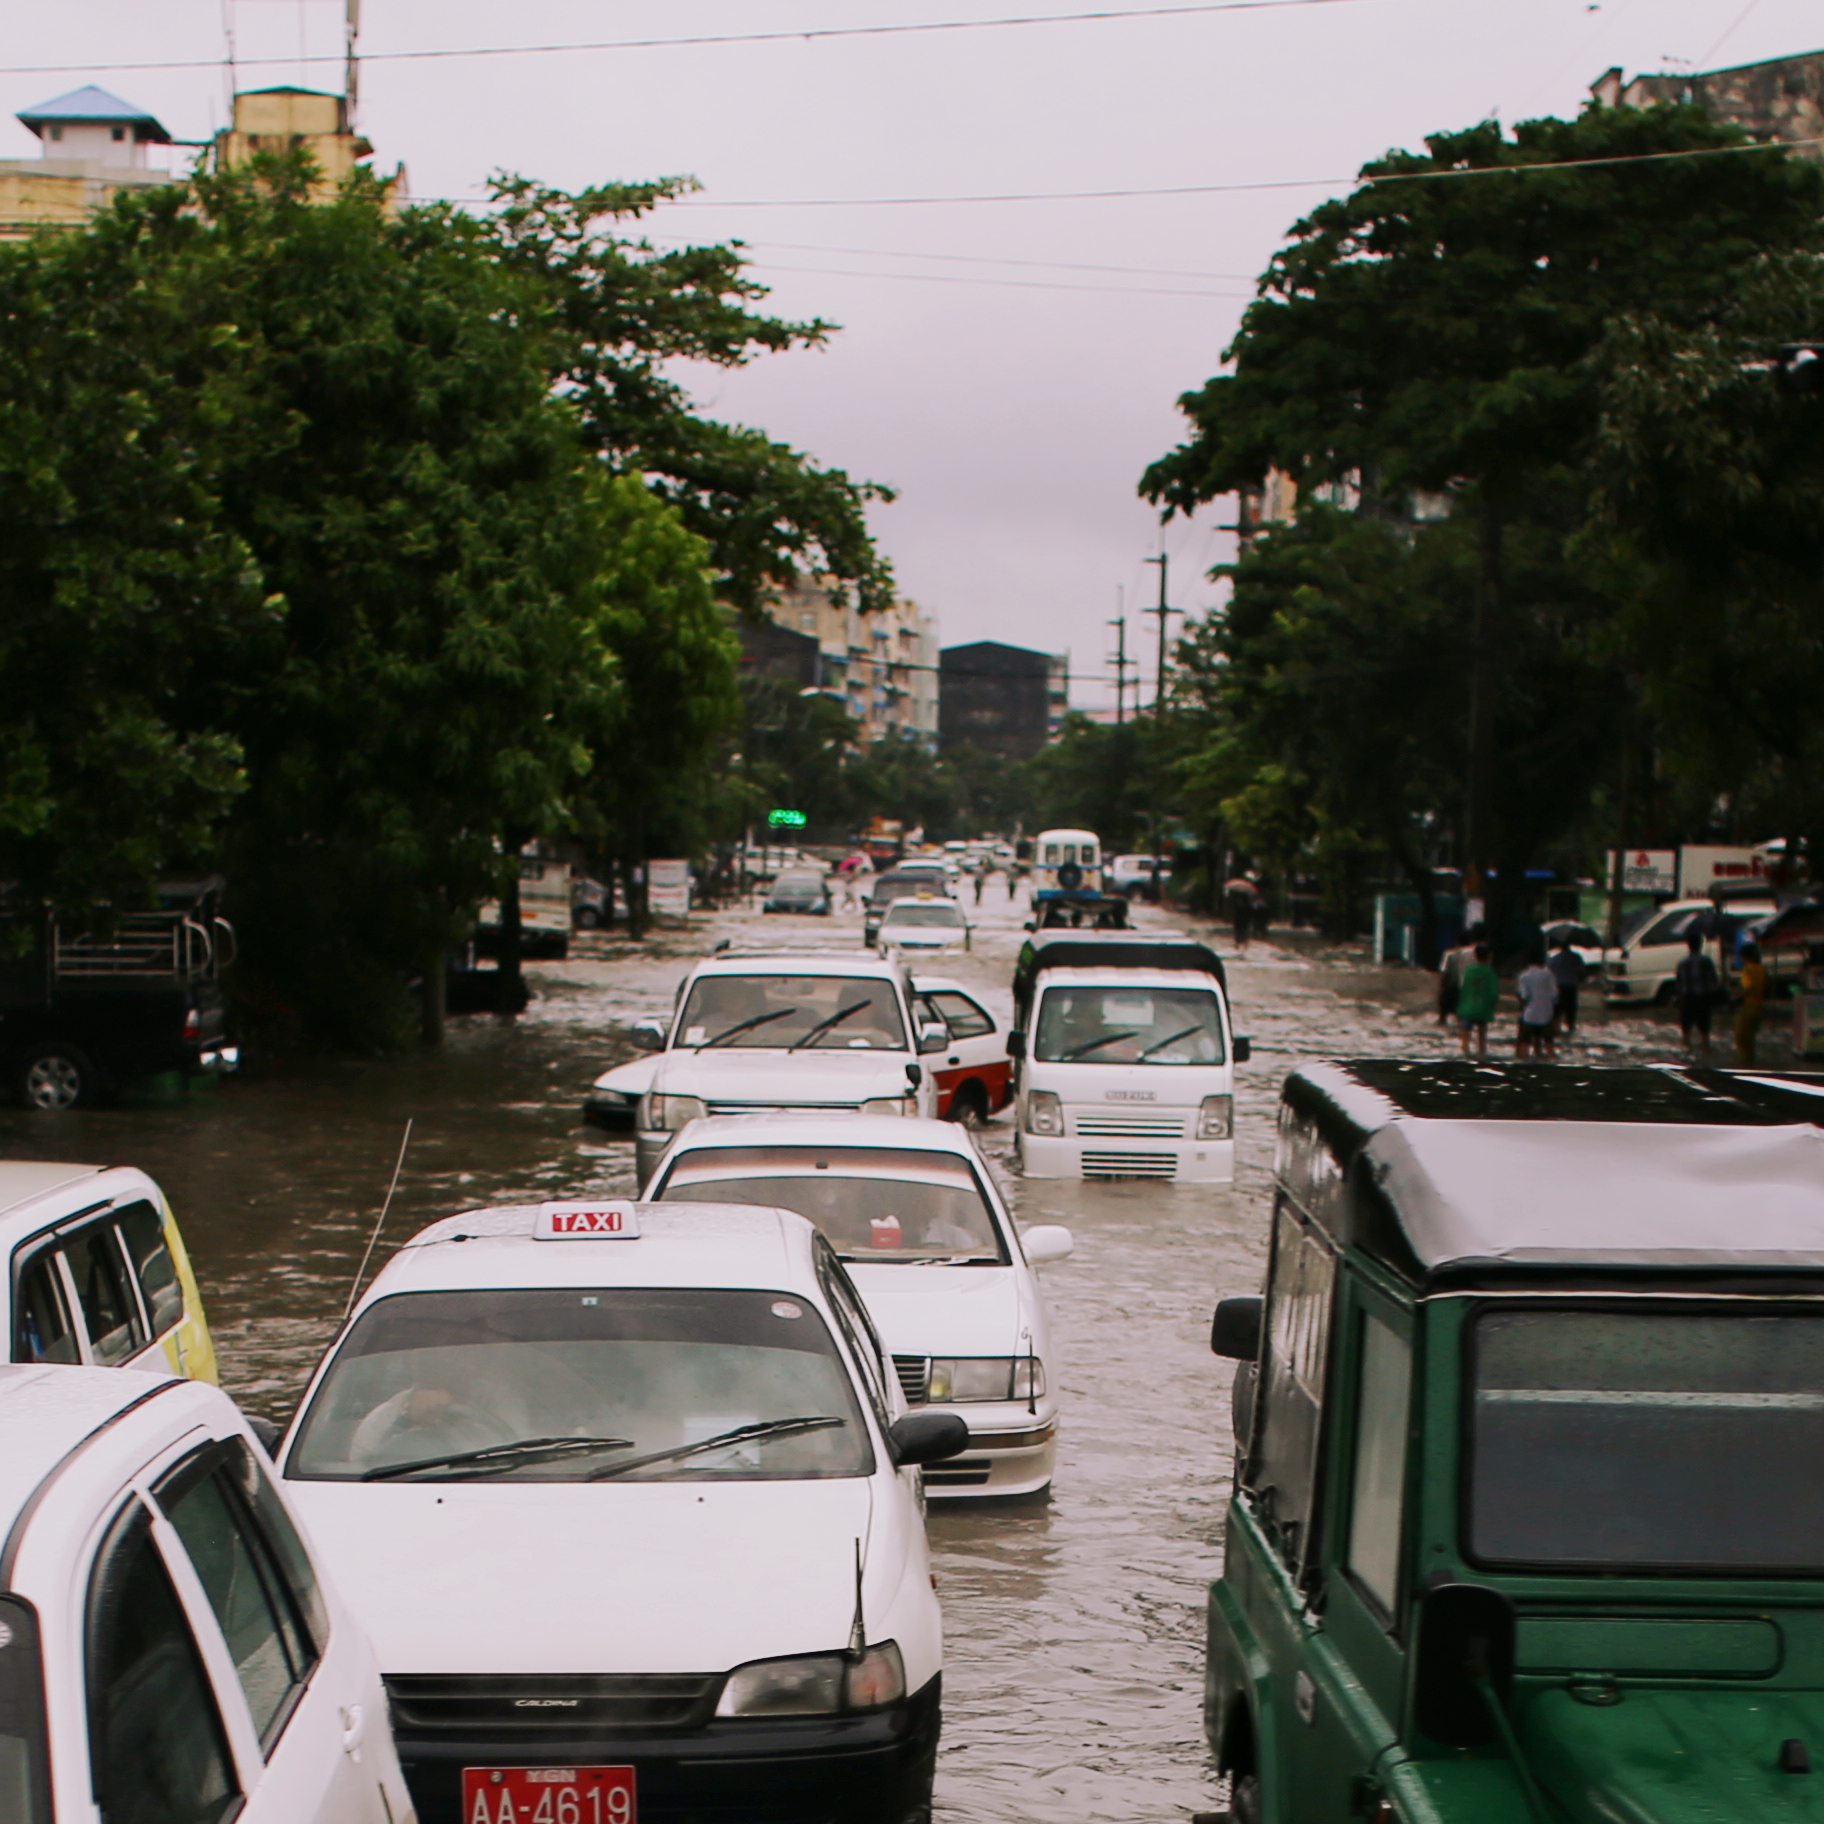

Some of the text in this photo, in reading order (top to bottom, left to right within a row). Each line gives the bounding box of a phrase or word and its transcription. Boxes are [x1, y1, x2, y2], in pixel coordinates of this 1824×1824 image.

[555, 1213, 620, 1231] TAXI
[514, 1699, 578, 1708] CALDINA
[526, 1769, 577, 1784] YGN
